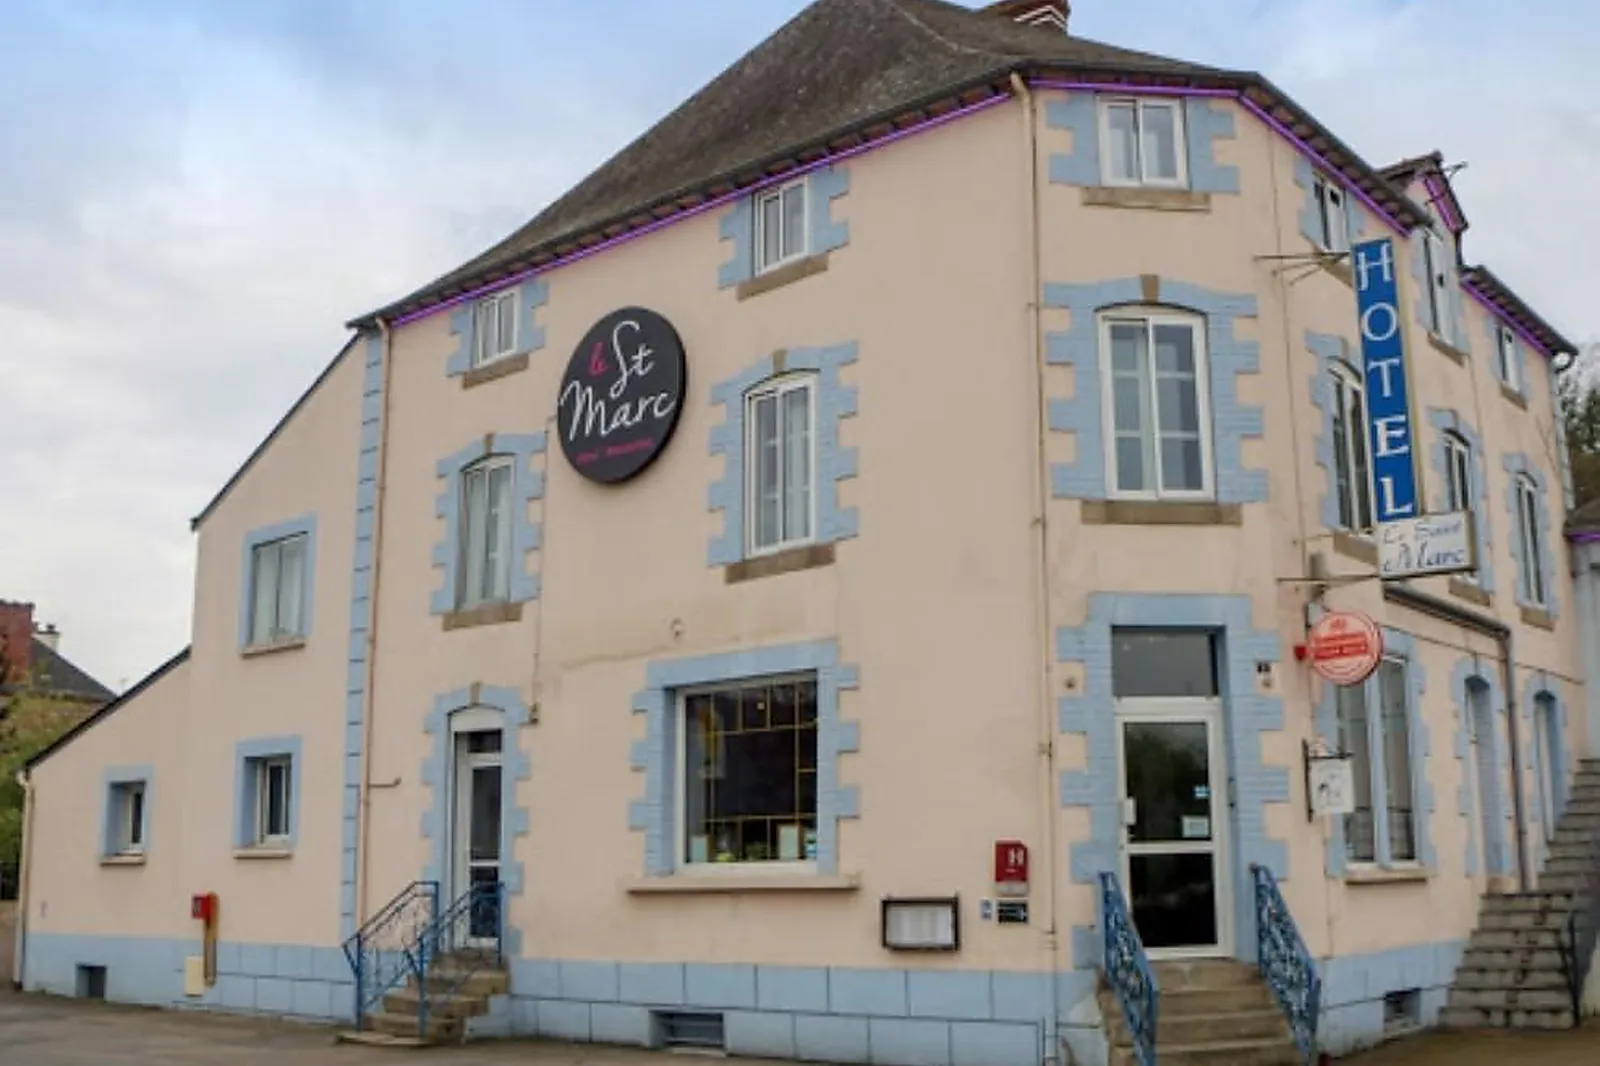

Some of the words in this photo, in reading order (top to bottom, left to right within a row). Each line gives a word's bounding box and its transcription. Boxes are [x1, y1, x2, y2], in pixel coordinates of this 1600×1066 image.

[609, 320, 654, 399] St
[1357, 242, 1413, 514] HOTEL
[559, 380, 677, 441] Marc
